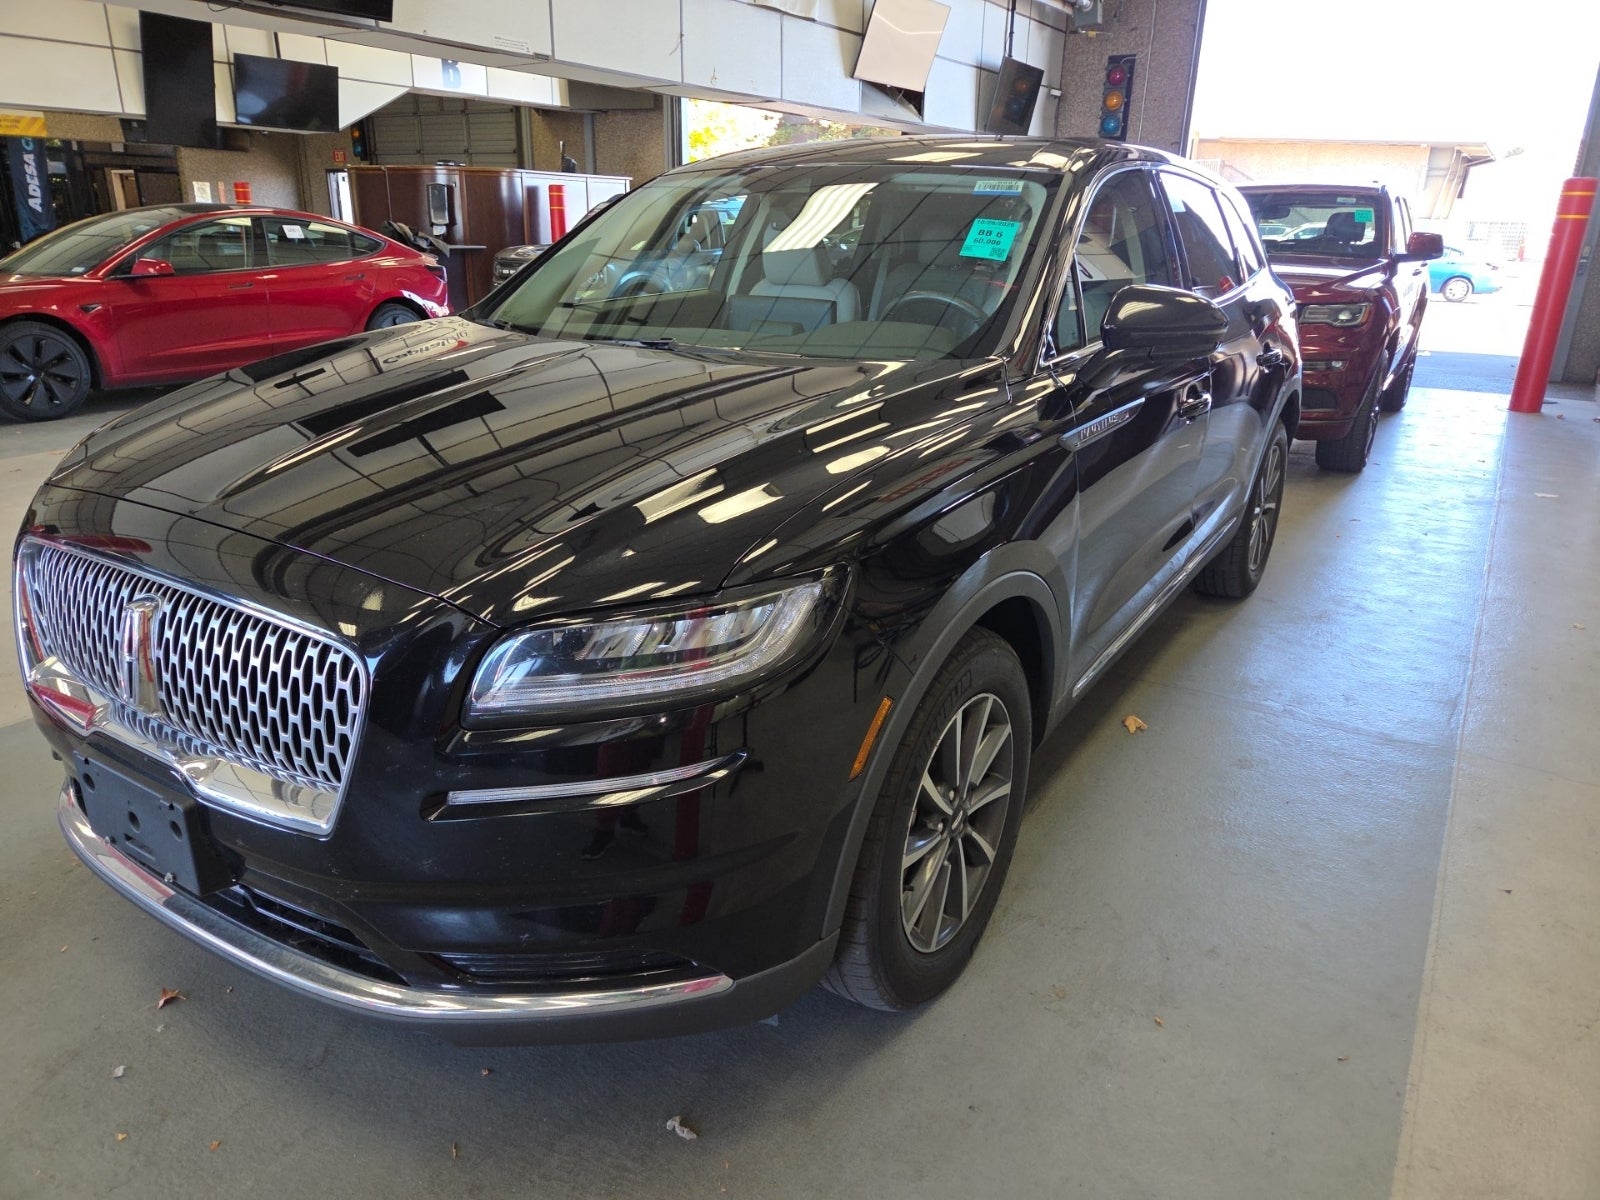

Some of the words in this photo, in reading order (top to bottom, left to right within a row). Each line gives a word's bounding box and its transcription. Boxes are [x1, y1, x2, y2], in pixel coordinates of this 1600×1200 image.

[441, 58, 462, 89] B
[23, 153, 42, 213] ADESA
[978, 229, 992, 237] BB
